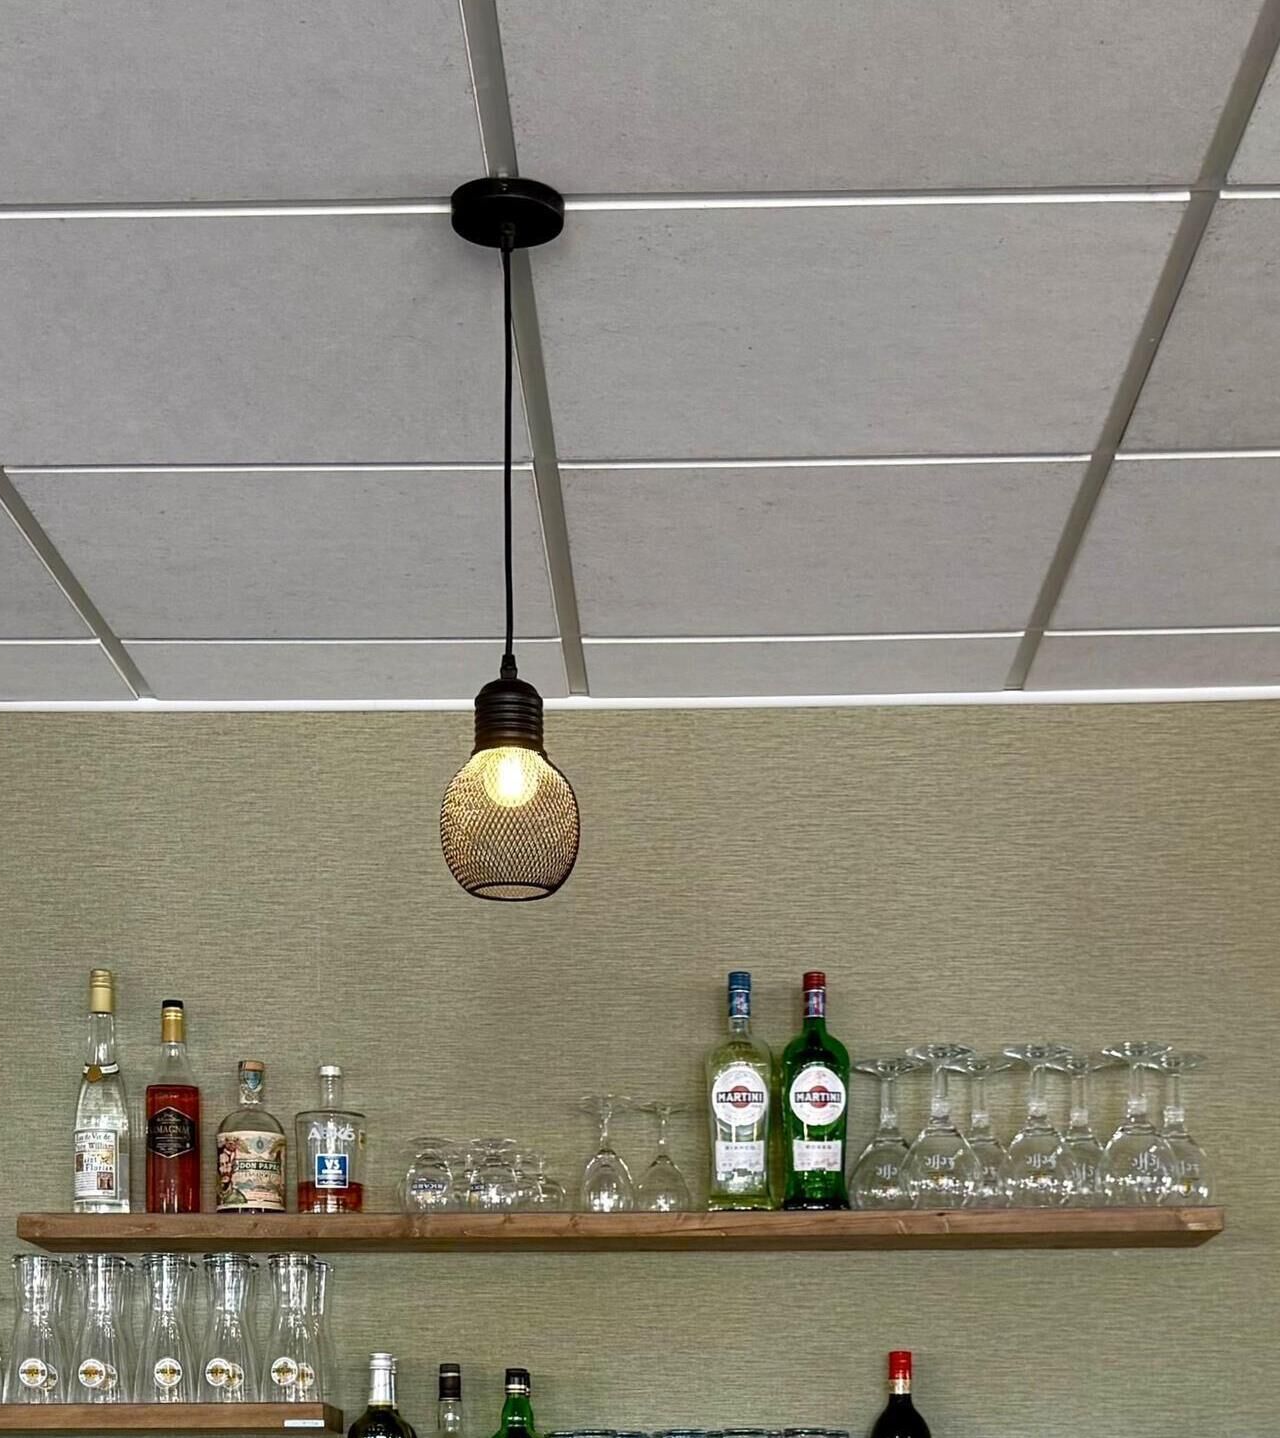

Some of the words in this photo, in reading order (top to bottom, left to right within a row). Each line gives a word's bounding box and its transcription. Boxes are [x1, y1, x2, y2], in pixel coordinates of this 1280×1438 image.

[718, 1091, 763, 1102] MARTINI
[796, 1091, 840, 1102] MARTINI
[323, 1159, 341, 1170] VS
